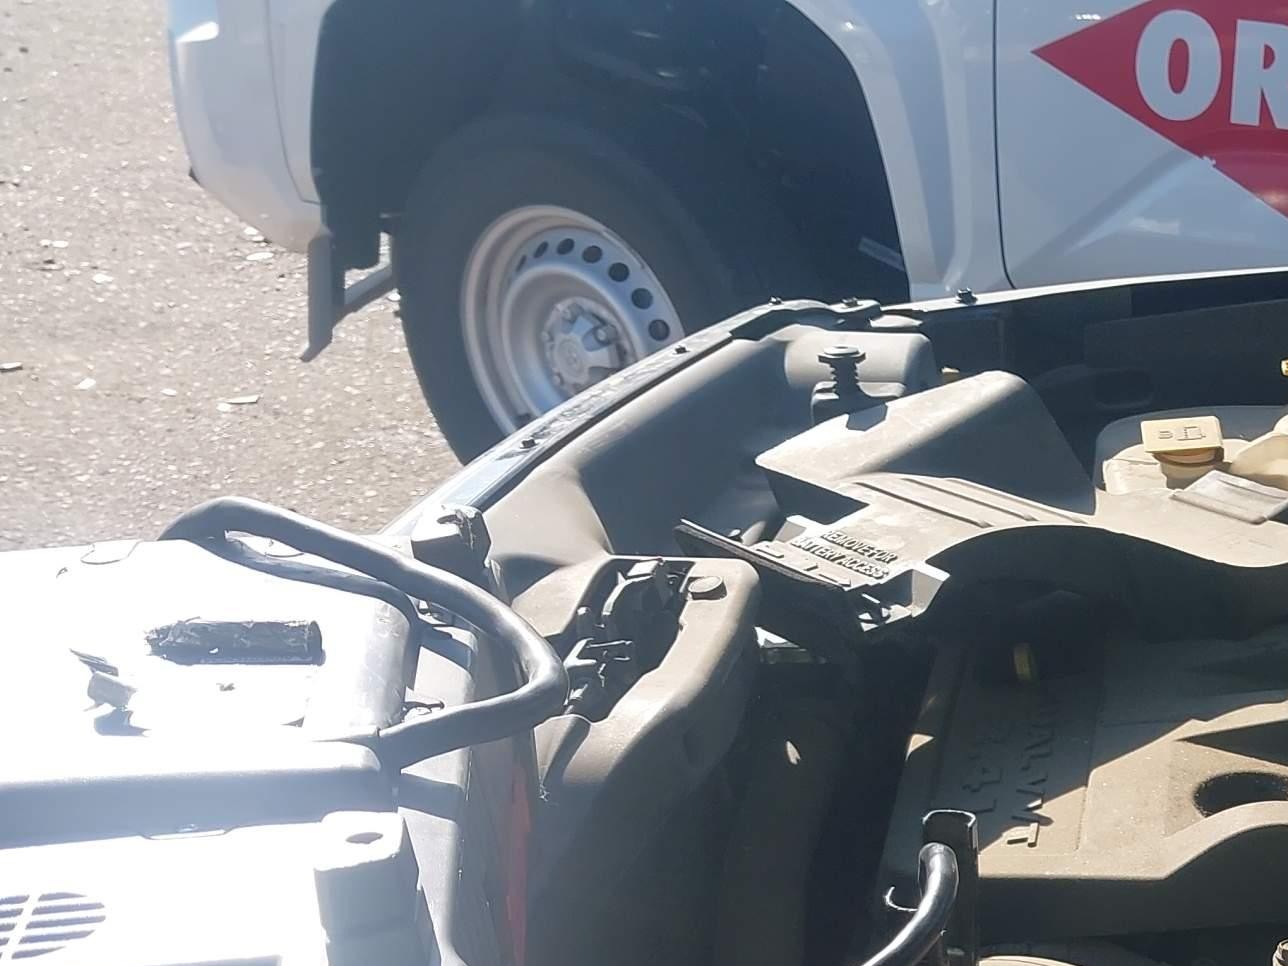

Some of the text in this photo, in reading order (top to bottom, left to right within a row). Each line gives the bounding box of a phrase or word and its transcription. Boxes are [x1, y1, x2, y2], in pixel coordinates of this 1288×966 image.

[820, 530, 898, 564] REMOVE FOR
[837, 556, 889, 580] ACCESS
